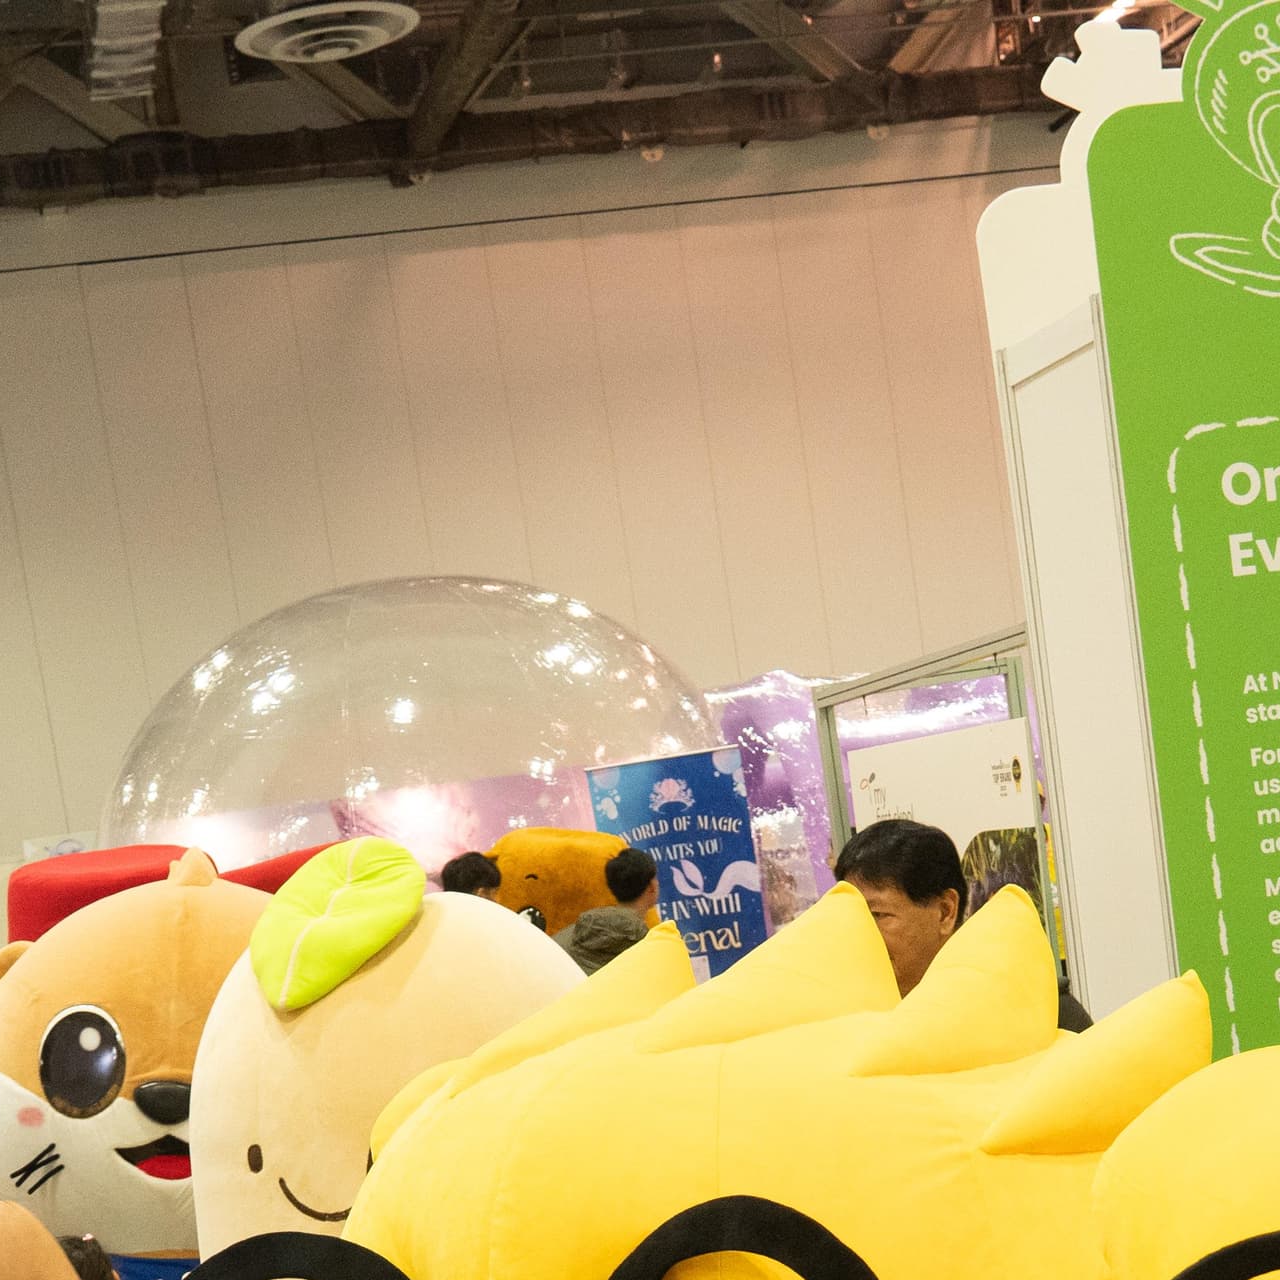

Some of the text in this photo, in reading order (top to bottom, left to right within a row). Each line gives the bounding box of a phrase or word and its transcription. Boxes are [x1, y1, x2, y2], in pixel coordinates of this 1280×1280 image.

[1243, 674, 1267, 694] At
[1254, 778, 1280, 796] us
[673, 815, 692, 832] OF
[697, 815, 743, 833] MAGIC
[644, 838, 723, 861] WAITS YOU
